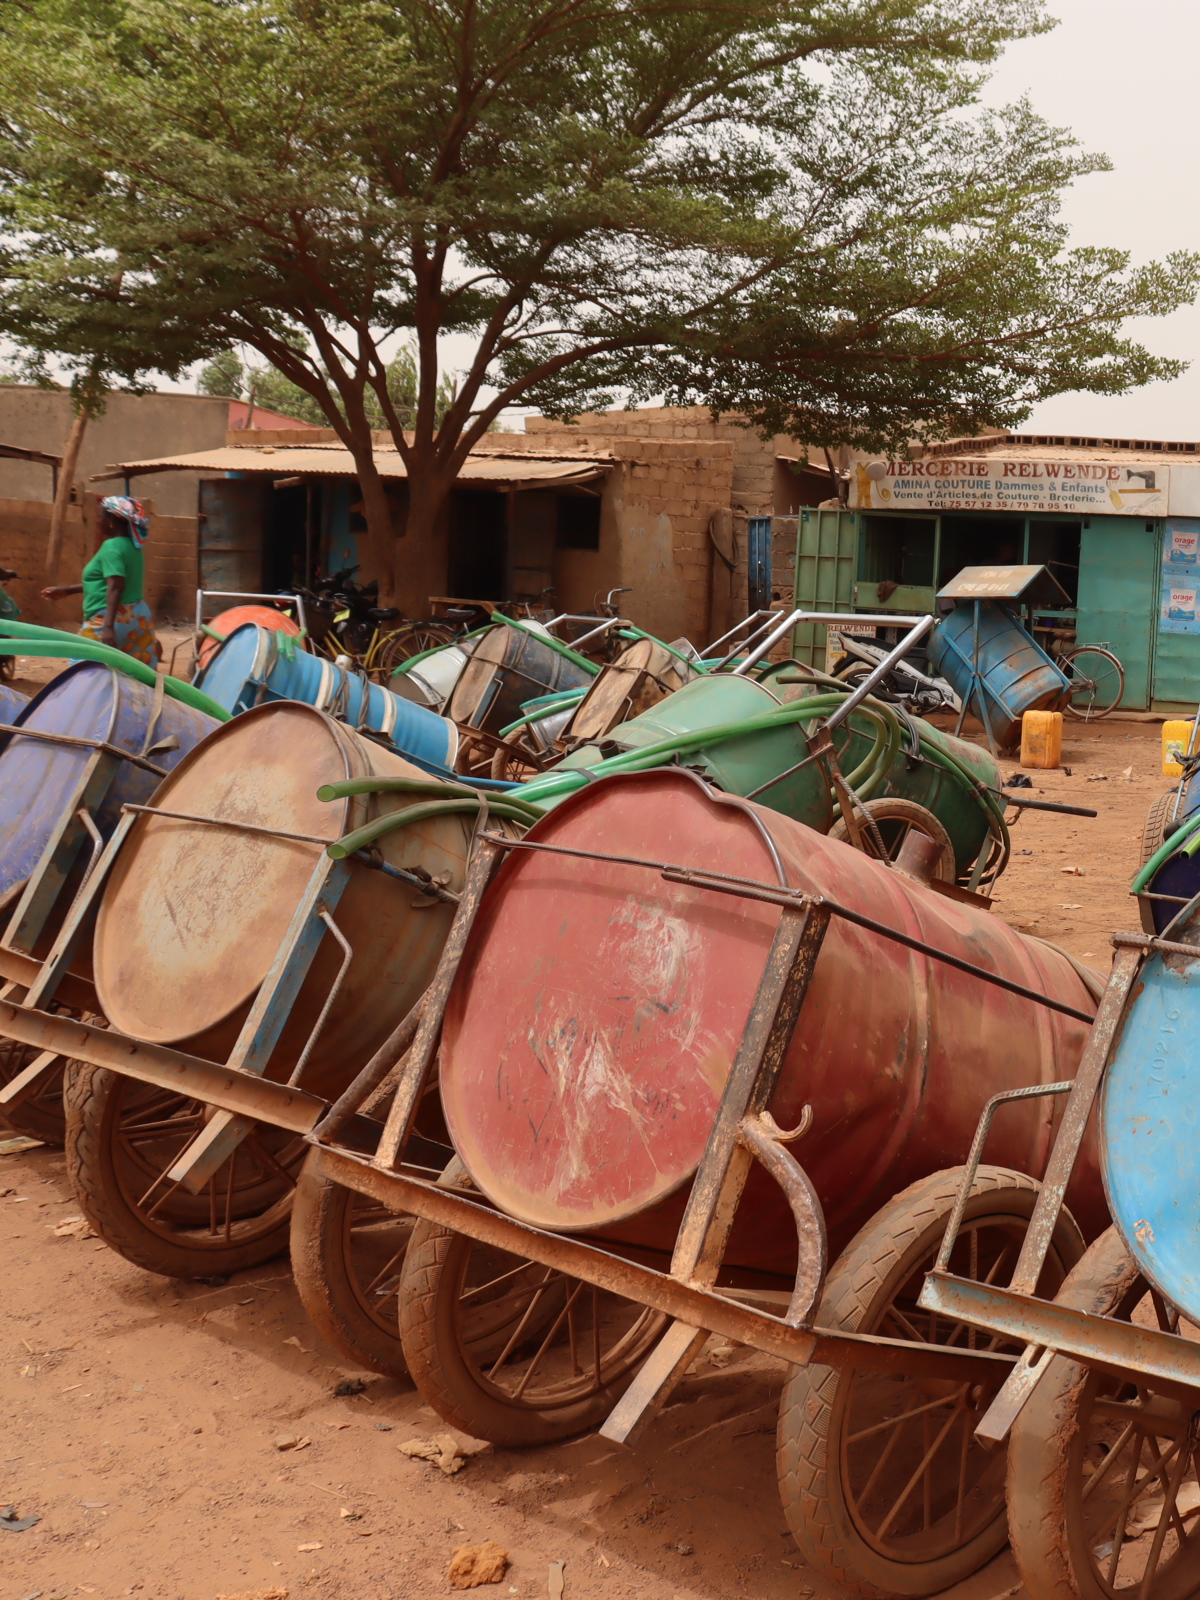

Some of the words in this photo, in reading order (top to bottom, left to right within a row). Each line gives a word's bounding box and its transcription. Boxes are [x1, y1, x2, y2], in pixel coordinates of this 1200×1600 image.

[883, 461, 989, 477] MERCERIE
[1002, 462, 1121, 481] RELWENDE
[893, 479, 931, 489] AMINA
[934, 479, 991, 490] COUTURE
[995, 480, 1045, 492] Dammes
[1048, 481, 1057, 491] &
[1061, 482, 1106, 494] Enfants
[893, 491, 924, 499] Vente
[926, 490, 977, 499] d'Articles
[980, 491, 993, 499] de
[997, 492, 1040, 501] Couture
[928, 500, 946, 508] Tél:
[949, 500, 961, 508] 75
[1016, 501, 1029, 509] 79
[1047, 502, 1060, 510] 95
[1174, 537, 1196, 545] orage
[1172, 594, 1194, 602] orage
